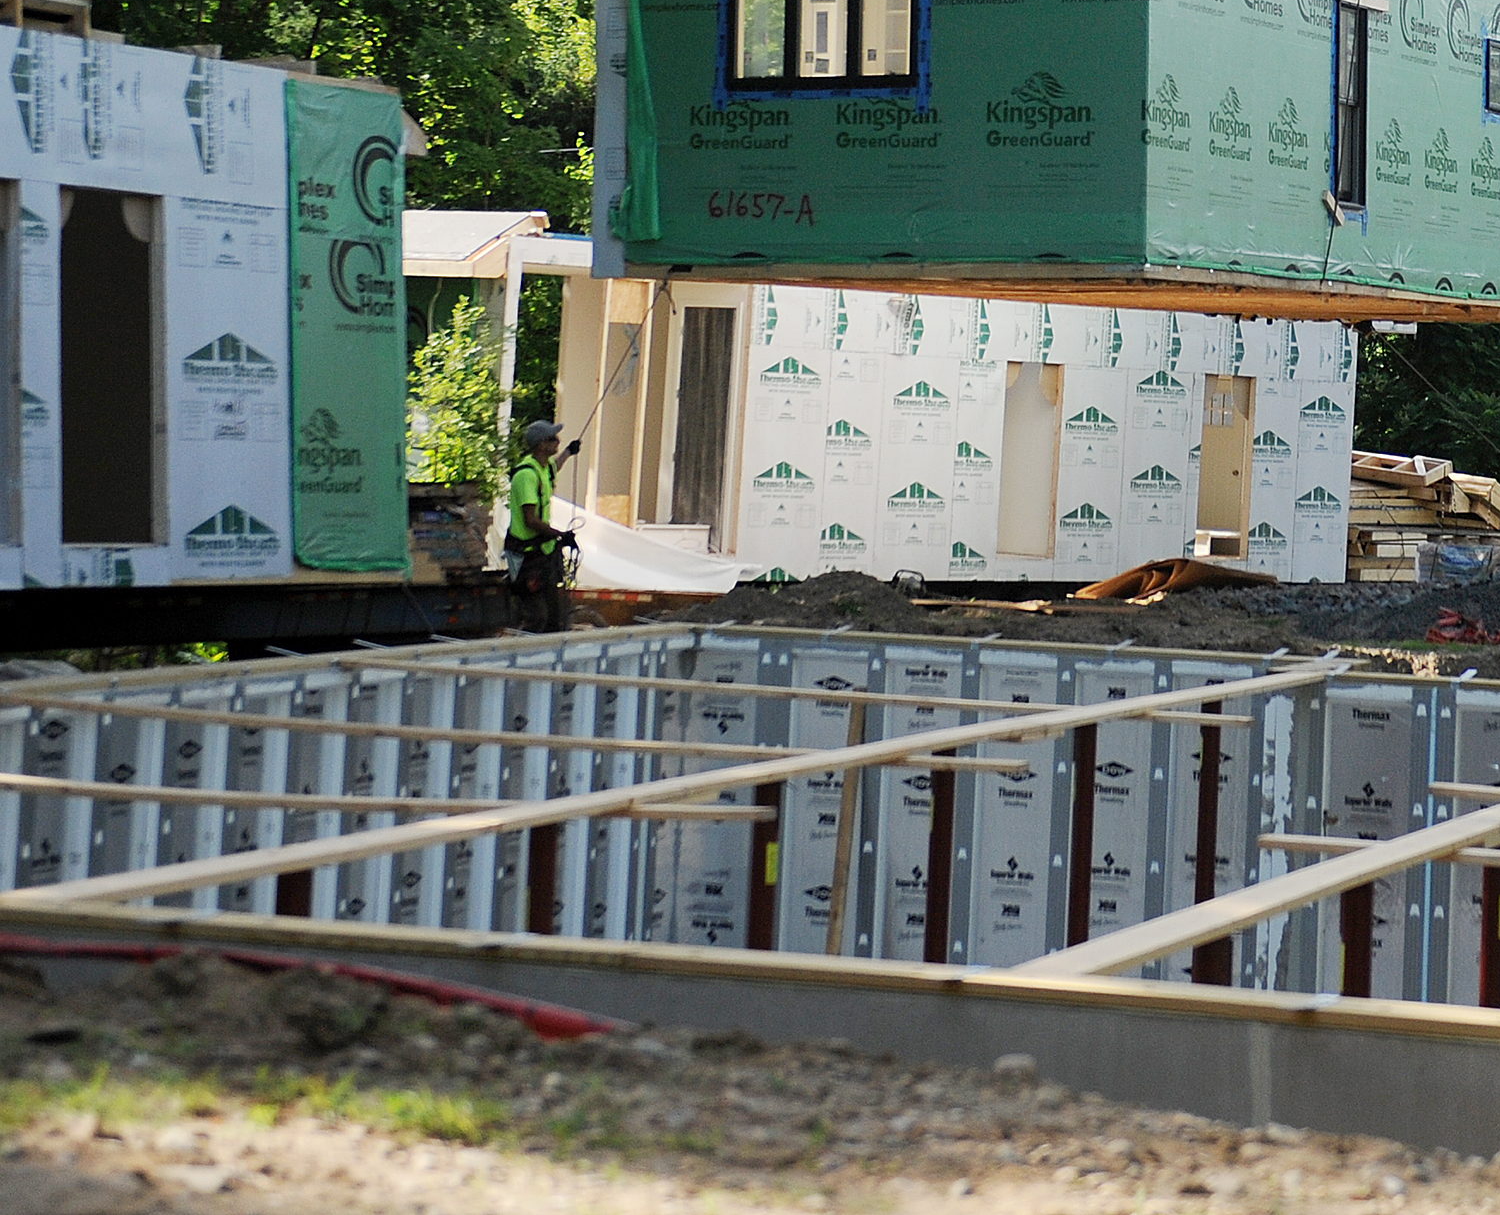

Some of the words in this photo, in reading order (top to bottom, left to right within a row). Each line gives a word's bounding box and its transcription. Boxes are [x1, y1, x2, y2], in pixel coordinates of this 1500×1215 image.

[1368, 10, 1393, 27] mplex
[1410, 16, 1441, 38] Simplex
[1368, 27, 1389, 44] omes
[1411, 34, 1437, 55] Homes
[1457, 29, 1483, 49] Simple
[1458, 45, 1482, 66] Homes
[690, 105, 790, 132] Kingspan
[836, 103, 940, 131] Kingspan
[986, 100, 1092, 130] Kingspan
[1141, 99, 1191, 132] Kingspan
[1208, 111, 1250, 142] Kingspan
[1268, 122, 1308, 152] Kingspan
[690, 134, 790, 150] GreenGuard
[836, 132, 940, 149] GreenGuard
[986, 130, 1092, 147] GreenGuard
[1141, 129, 1191, 153] GreenGuard
[1208, 139, 1251, 162] GreenGuard
[1268, 149, 1308, 171] GreenGuard
[1375, 141, 1411, 169] Kingspan
[1424, 149, 1458, 177] Kingspan
[1375, 167, 1411, 187] GreenGuard
[1424, 174, 1458, 194] GreenGuard
[298, 177, 336, 200] plex
[708, 190, 815, 227] 61657-A
[356, 273, 396, 299] Simp
[360, 295, 395, 317] Hom
[298, 448, 361, 474] ngspan
[998, 786, 1033, 799] Thermax
[1093, 783, 1130, 796] Thermax
